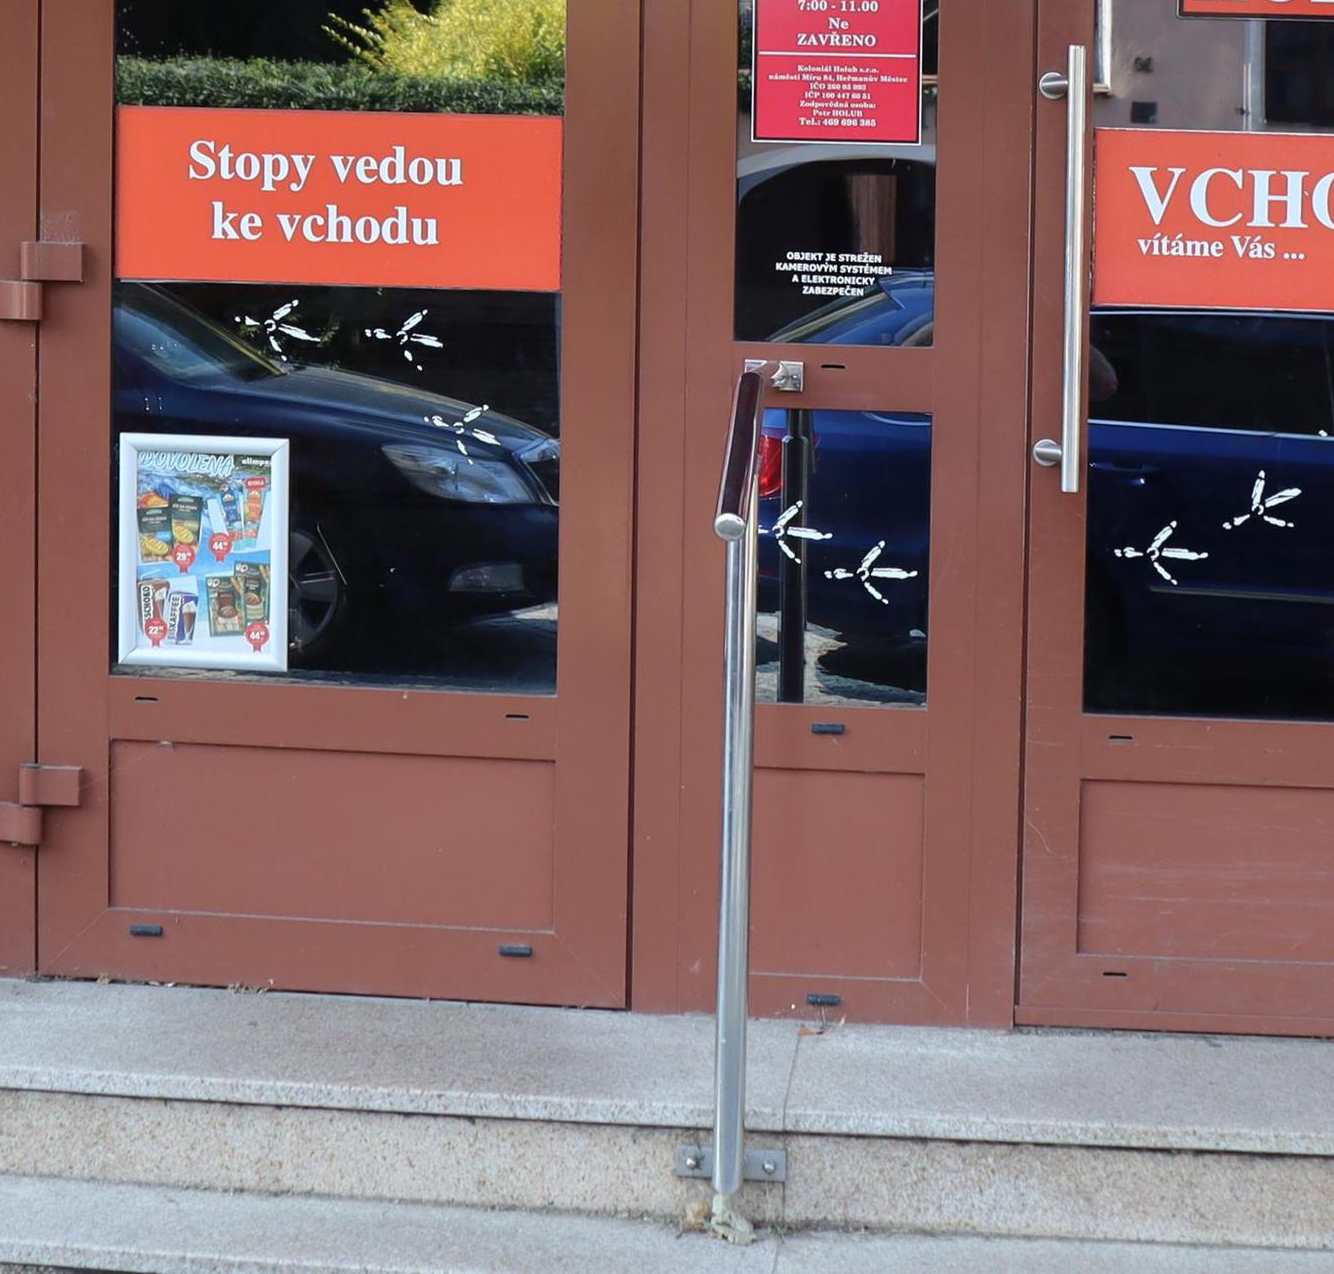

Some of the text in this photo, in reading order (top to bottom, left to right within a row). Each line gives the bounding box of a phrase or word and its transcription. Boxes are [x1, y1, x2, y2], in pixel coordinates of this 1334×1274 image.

[798, 0, 827, 11] 7:00
[841, 0, 878, 12] 11.00
[829, 18, 849, 29] Ne
[797, 31, 876, 46] ZAVŘENO
[188, 140, 463, 192] Stopy vedou
[211, 201, 440, 246] ke vchodu
[1137, 232, 1224, 258] vítáme
[1231, 234, 1276, 259] Vás
[787, 251, 824, 261] OBJEKT
[825, 253, 836, 261] JE
[776, 262, 892, 275] KAMEROVÝM SYSTÉMEM
[801, 275, 875, 285] ELEKTRONICKY
[803, 286, 864, 296] ZABEZPEČEN
